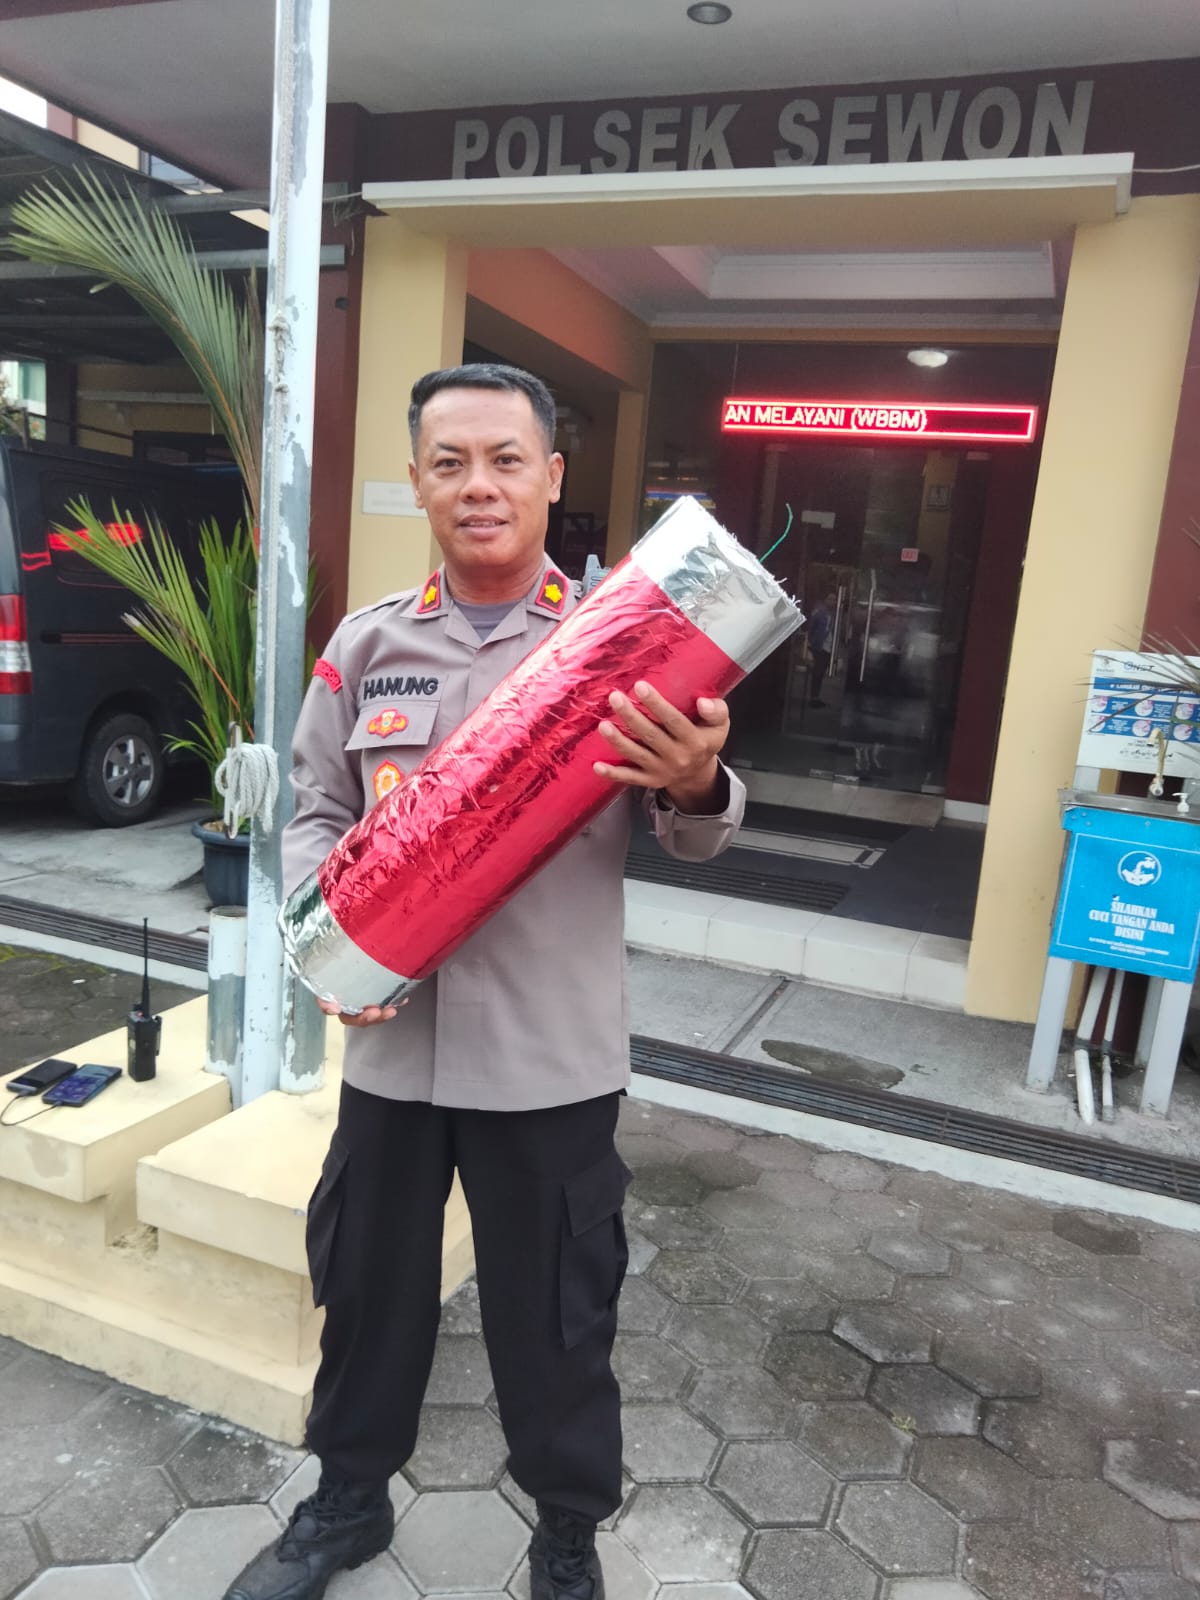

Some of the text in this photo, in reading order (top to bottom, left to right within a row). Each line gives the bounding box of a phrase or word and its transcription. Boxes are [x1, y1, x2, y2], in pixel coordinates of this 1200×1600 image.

[452, 80, 1095, 180] POLSEK SEWON
[725, 405, 927, 432] AN MELAYANI (WBBM)
[363, 676, 439, 700] HANUNG
[1111, 913, 1149, 930] TANGAN
